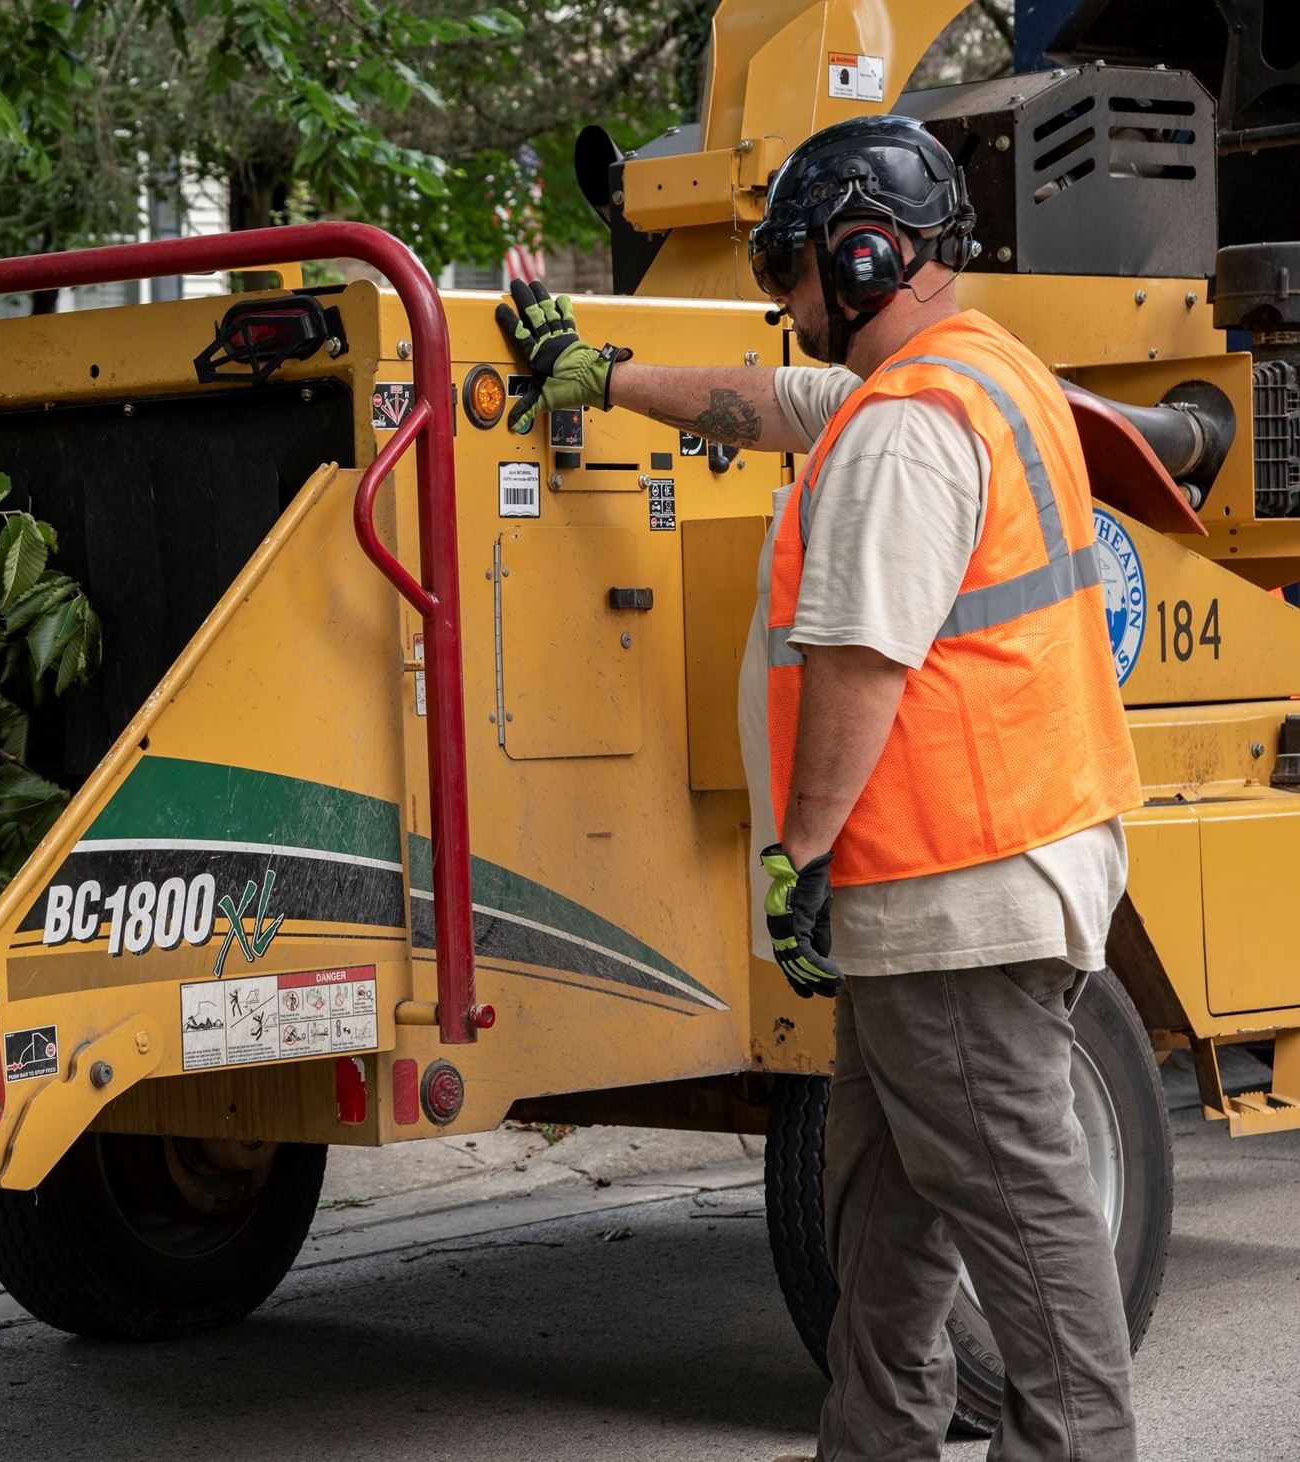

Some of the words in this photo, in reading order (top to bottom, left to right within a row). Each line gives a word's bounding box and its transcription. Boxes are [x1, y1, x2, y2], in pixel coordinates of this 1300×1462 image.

[1157, 598, 1221, 663] 184
[213, 870, 285, 977] XL
[316, 971, 347, 983] DANGER
